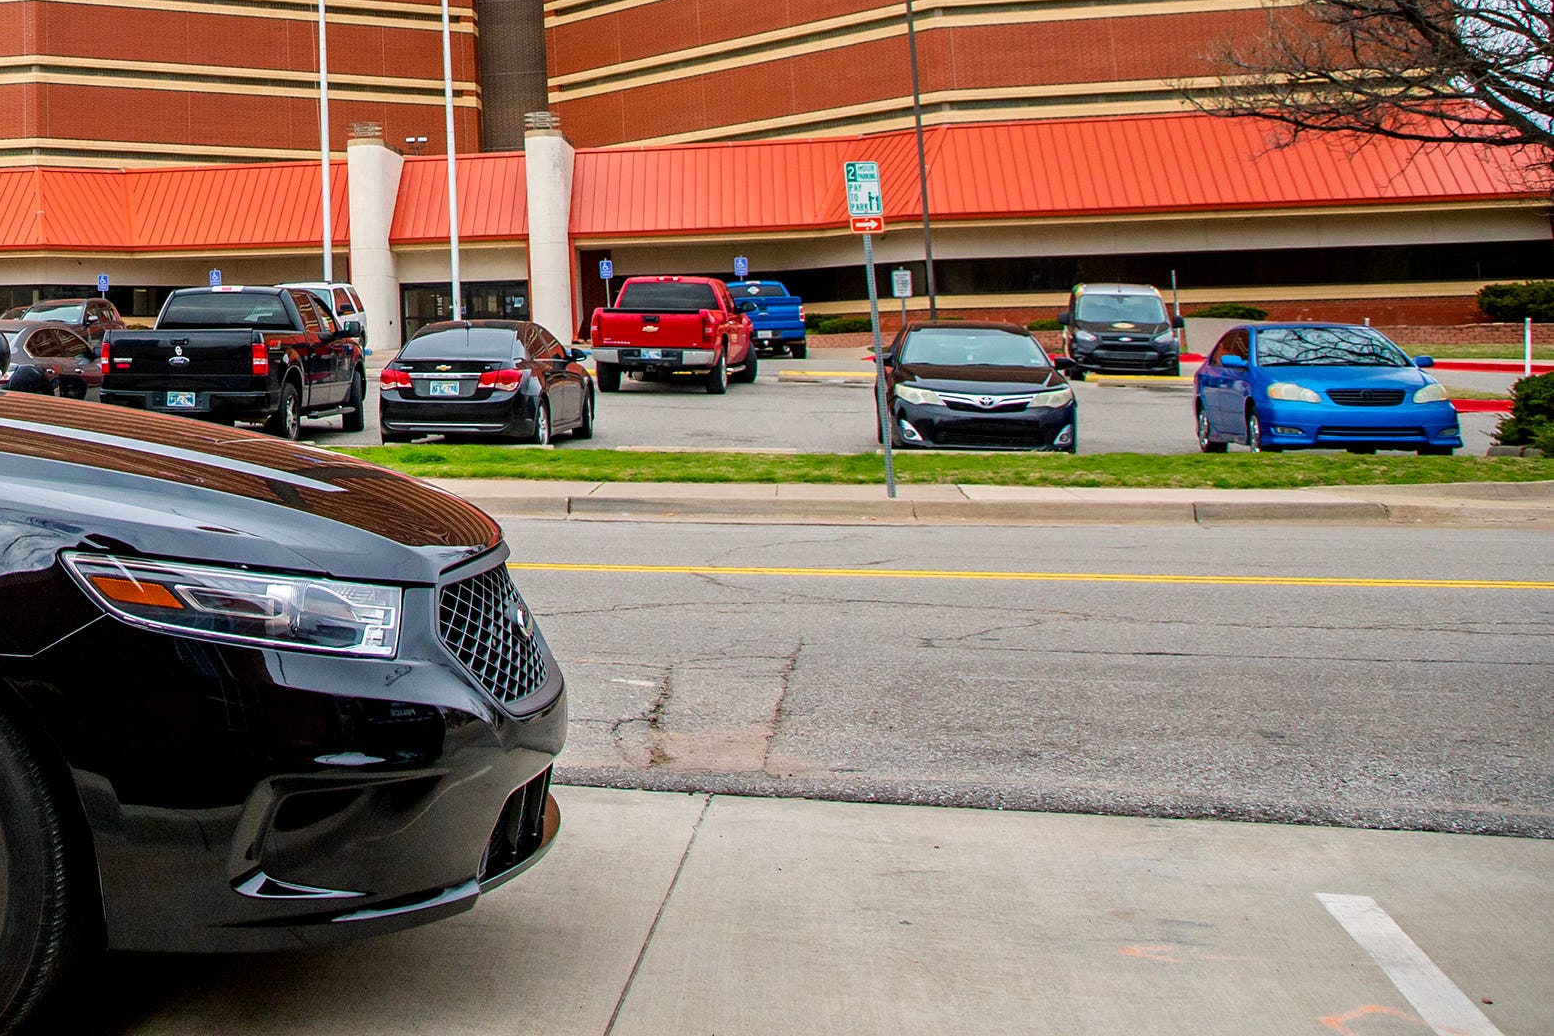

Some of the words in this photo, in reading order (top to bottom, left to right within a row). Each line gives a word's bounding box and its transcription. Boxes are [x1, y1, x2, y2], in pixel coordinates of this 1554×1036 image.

[847, 166, 855, 180] 2
[849, 183, 862, 192] PAY
[850, 193, 859, 202] TO
[850, 203, 868, 211] PARK
